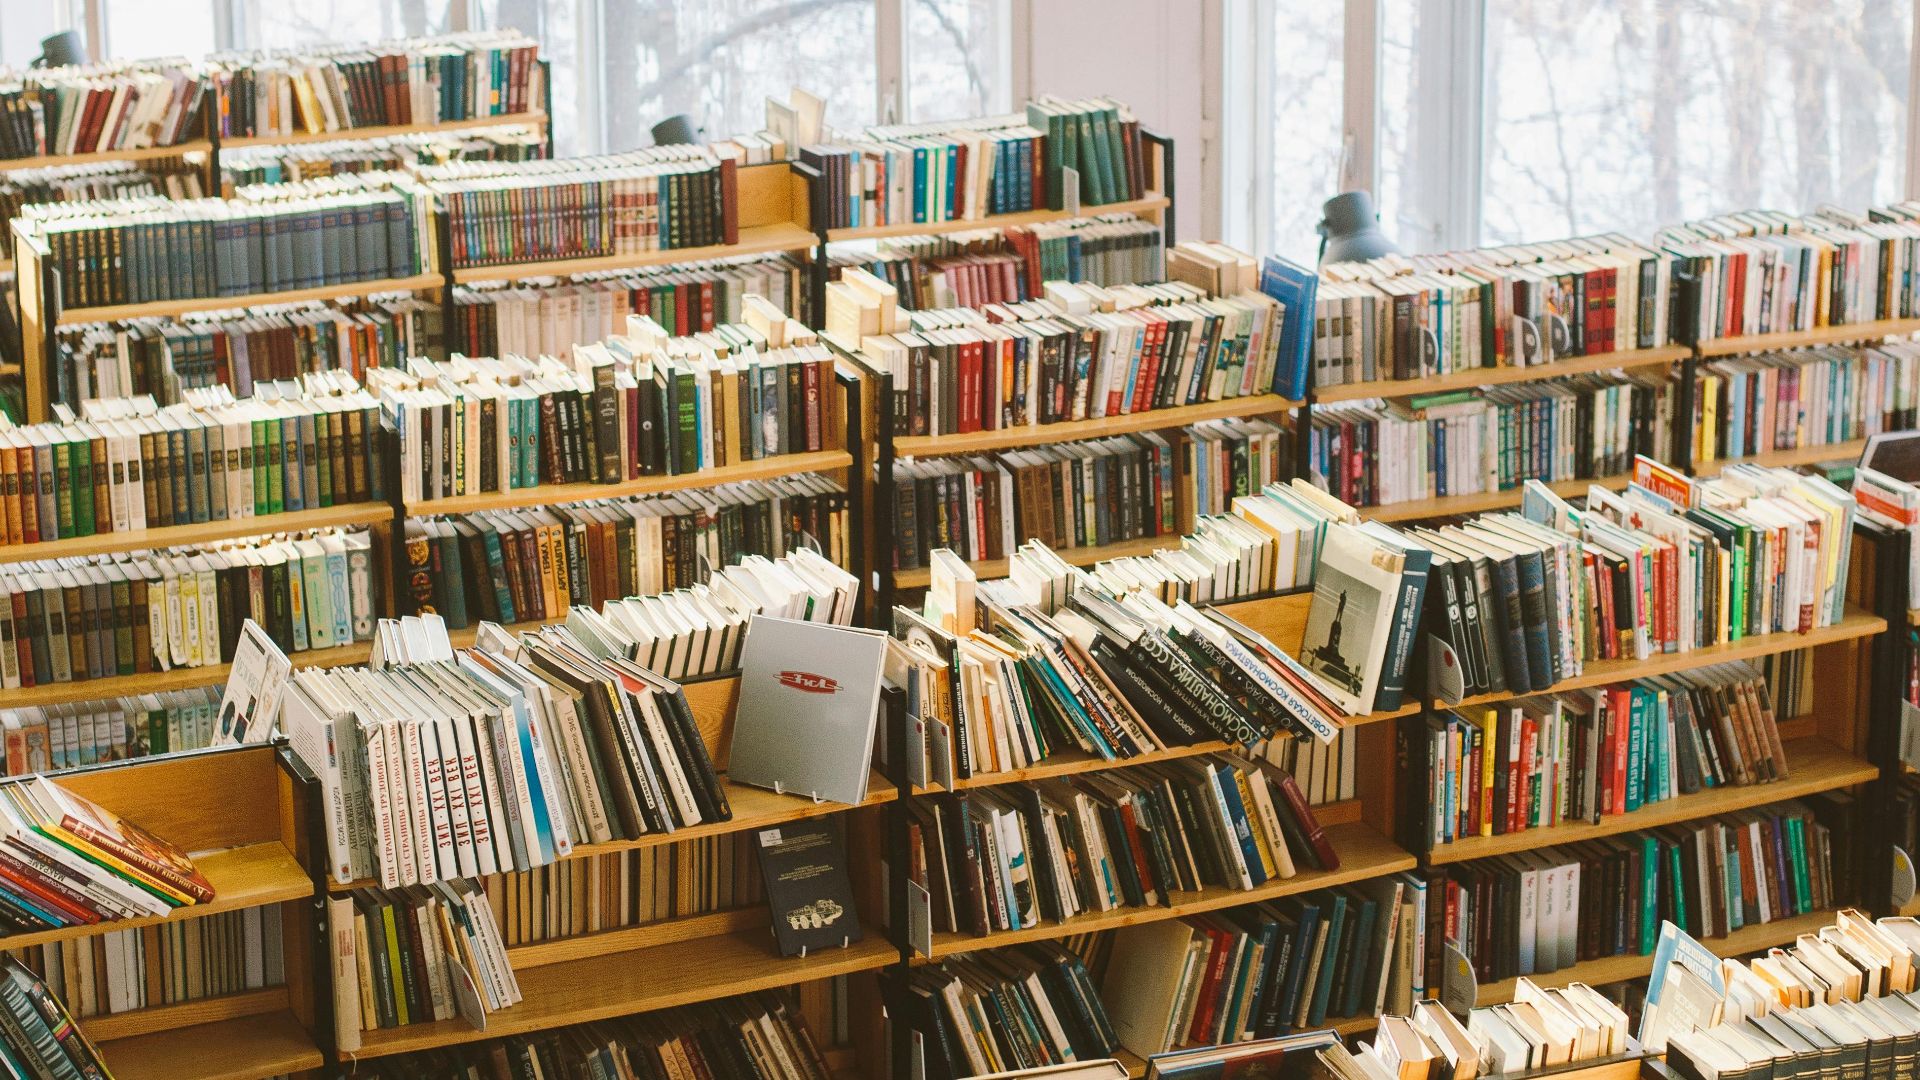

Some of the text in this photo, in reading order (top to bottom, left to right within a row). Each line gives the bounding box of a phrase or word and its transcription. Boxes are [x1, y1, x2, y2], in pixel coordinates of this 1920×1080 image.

[540, 542, 550, 574] ГЕРАКЛ
[553, 540, 566, 590] АРГОНАВТЫ
[1137, 632, 1171, 665] СССР
[1195, 636, 1231, 668] ЗВЕЗДАМ
[1124, 666, 1195, 736] ДОРОГА НА КОСМОДРОМ
[1164, 657, 1257, 747] КОСМОНАВТИКА
[1169, 682, 1224, 733] КОСМОНАВТИКА
[1222, 639, 1331, 737] СОВЕТСКАЯ КОСМОНАВТИКА
[1245, 681, 1269, 703] STARS
[392, 756, 404, 805] ТРУДОВОЙ
[482, 740, 496, 781] ГОРДОСТЬ
[499, 753, 514, 793] ГОРДОСТЬ
[510, 737, 524, 778] ГОРДОСТЬ
[375, 760, 388, 808] ТРУДОВОЙ
[406, 722, 433, 880] ЗИЛ СТРАНИЦЫ ТРУДОВОЙ СЛАВЫ
[427, 758, 451, 849] ЗИЛ XXI ВЕК
[445, 757, 471, 847] ЗИЛ XXI ВЕК
[463, 754, 489, 844] ЗИЛ XXI ВЕК
[344, 792, 358, 850] АВТОМОБИЛИ
[380, 812, 393, 862] СТРАНИЦЫ
[398, 809, 410, 859] СТРАНИЦЫ
[28, 858, 66, 882] МАКРАМЕ
[37, 871, 68, 894] Высоцкая
[386, 866, 395, 884] ЗИЛ
[65, 888, 84, 903] Юлия
